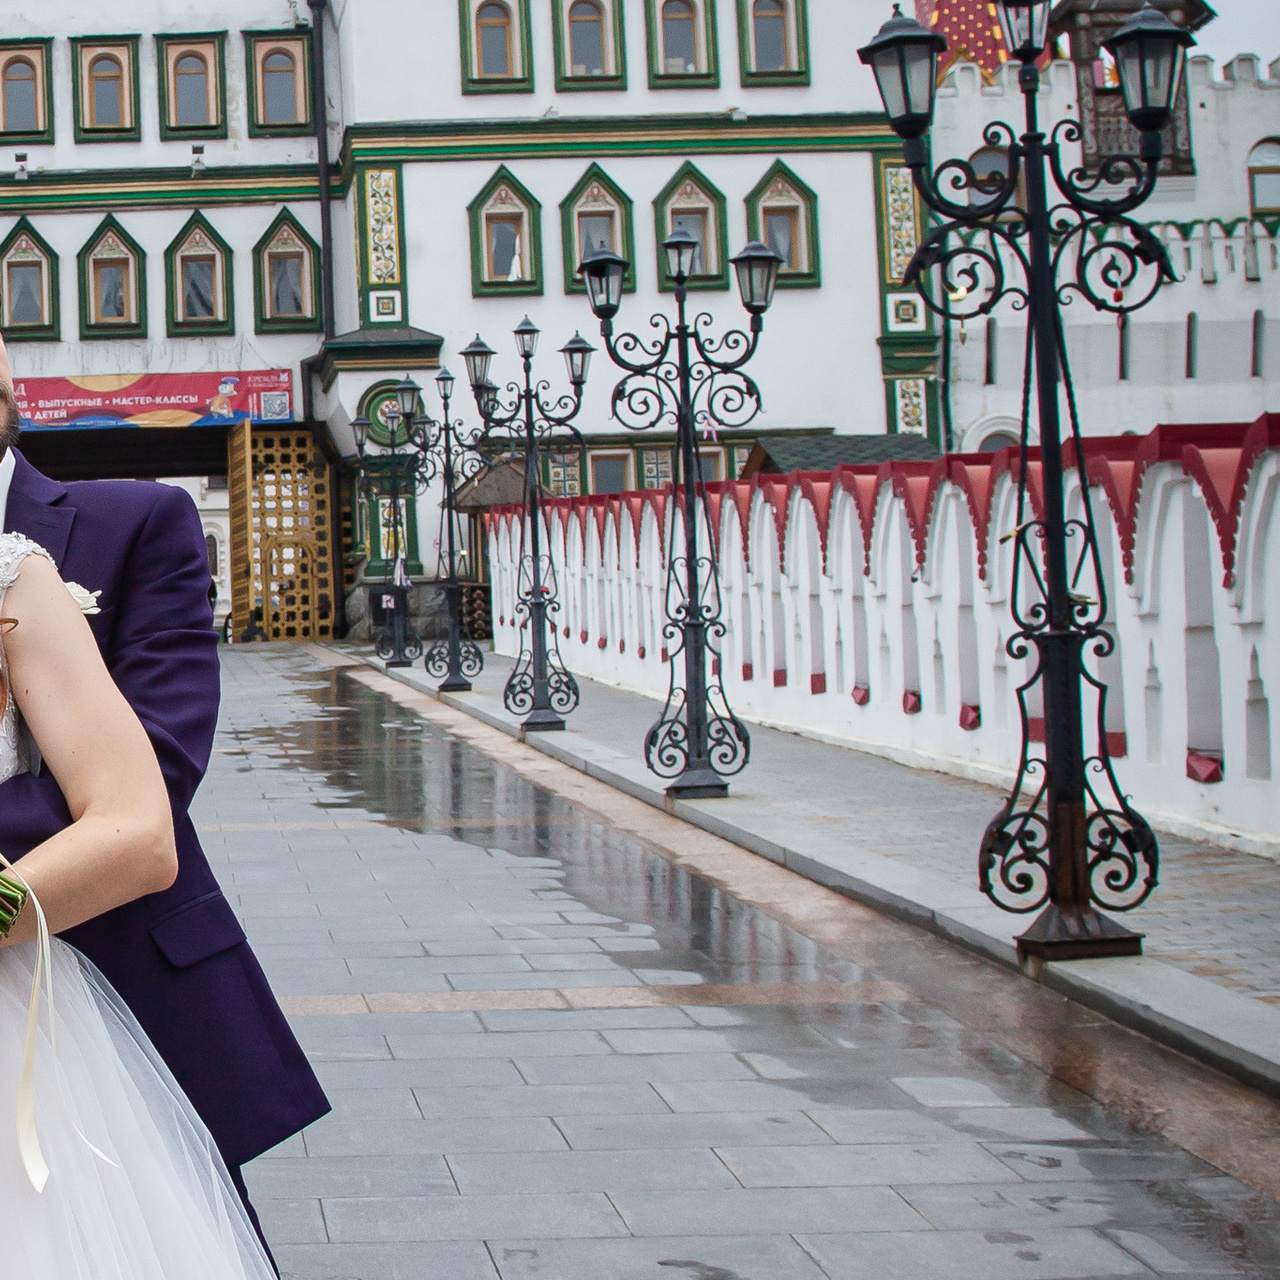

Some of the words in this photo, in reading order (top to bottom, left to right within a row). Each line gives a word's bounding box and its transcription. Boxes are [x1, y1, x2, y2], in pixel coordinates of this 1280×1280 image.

[38, 398, 103, 409] ВЫПУСКНЫЕ
[112, 394, 199, 406] МАСТЕР-КЛАССЫ
[34, 408, 67, 420] ДЕТЕЙ
